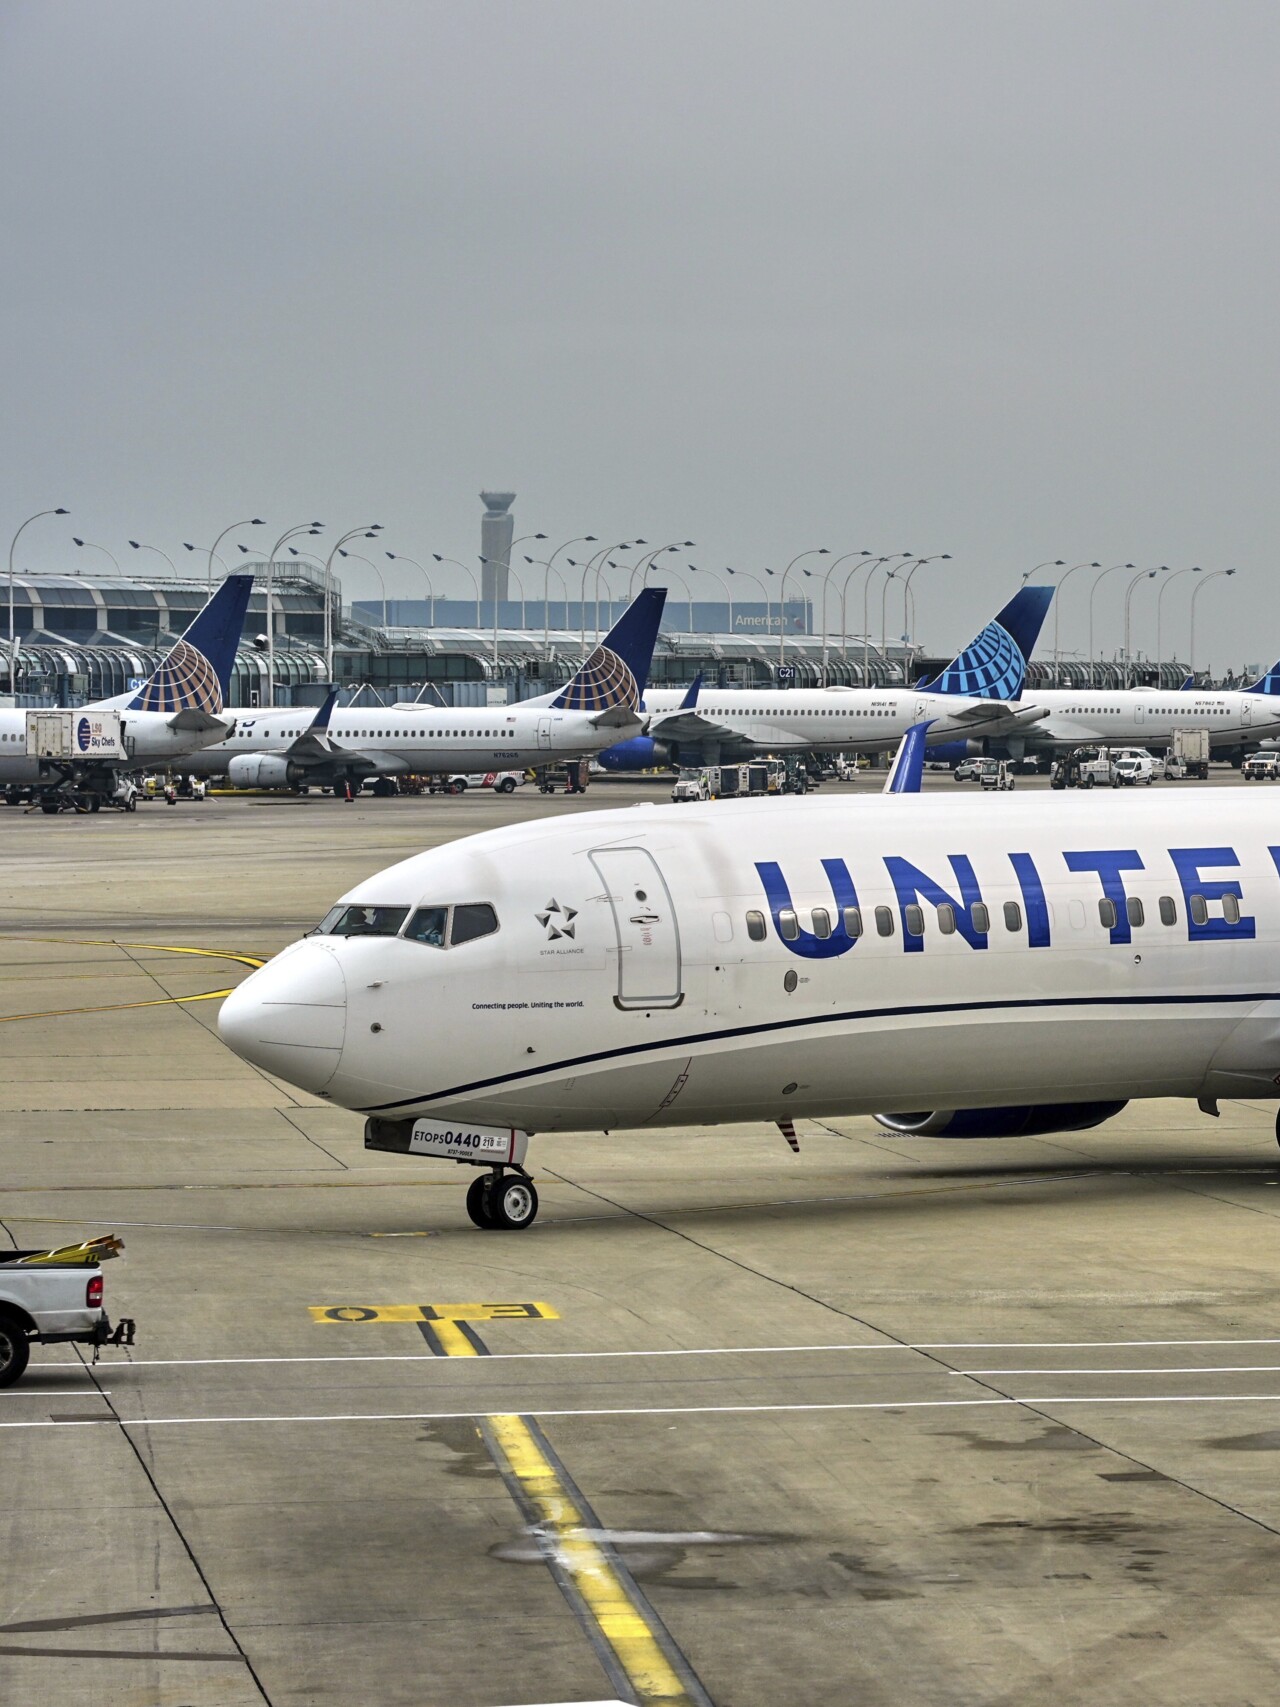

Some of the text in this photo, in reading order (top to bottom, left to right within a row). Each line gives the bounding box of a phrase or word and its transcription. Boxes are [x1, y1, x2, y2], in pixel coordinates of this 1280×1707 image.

[735, 615, 788, 626] American
[779, 668, 794, 678] C21
[91, 737, 115, 749] Sky Chefs
